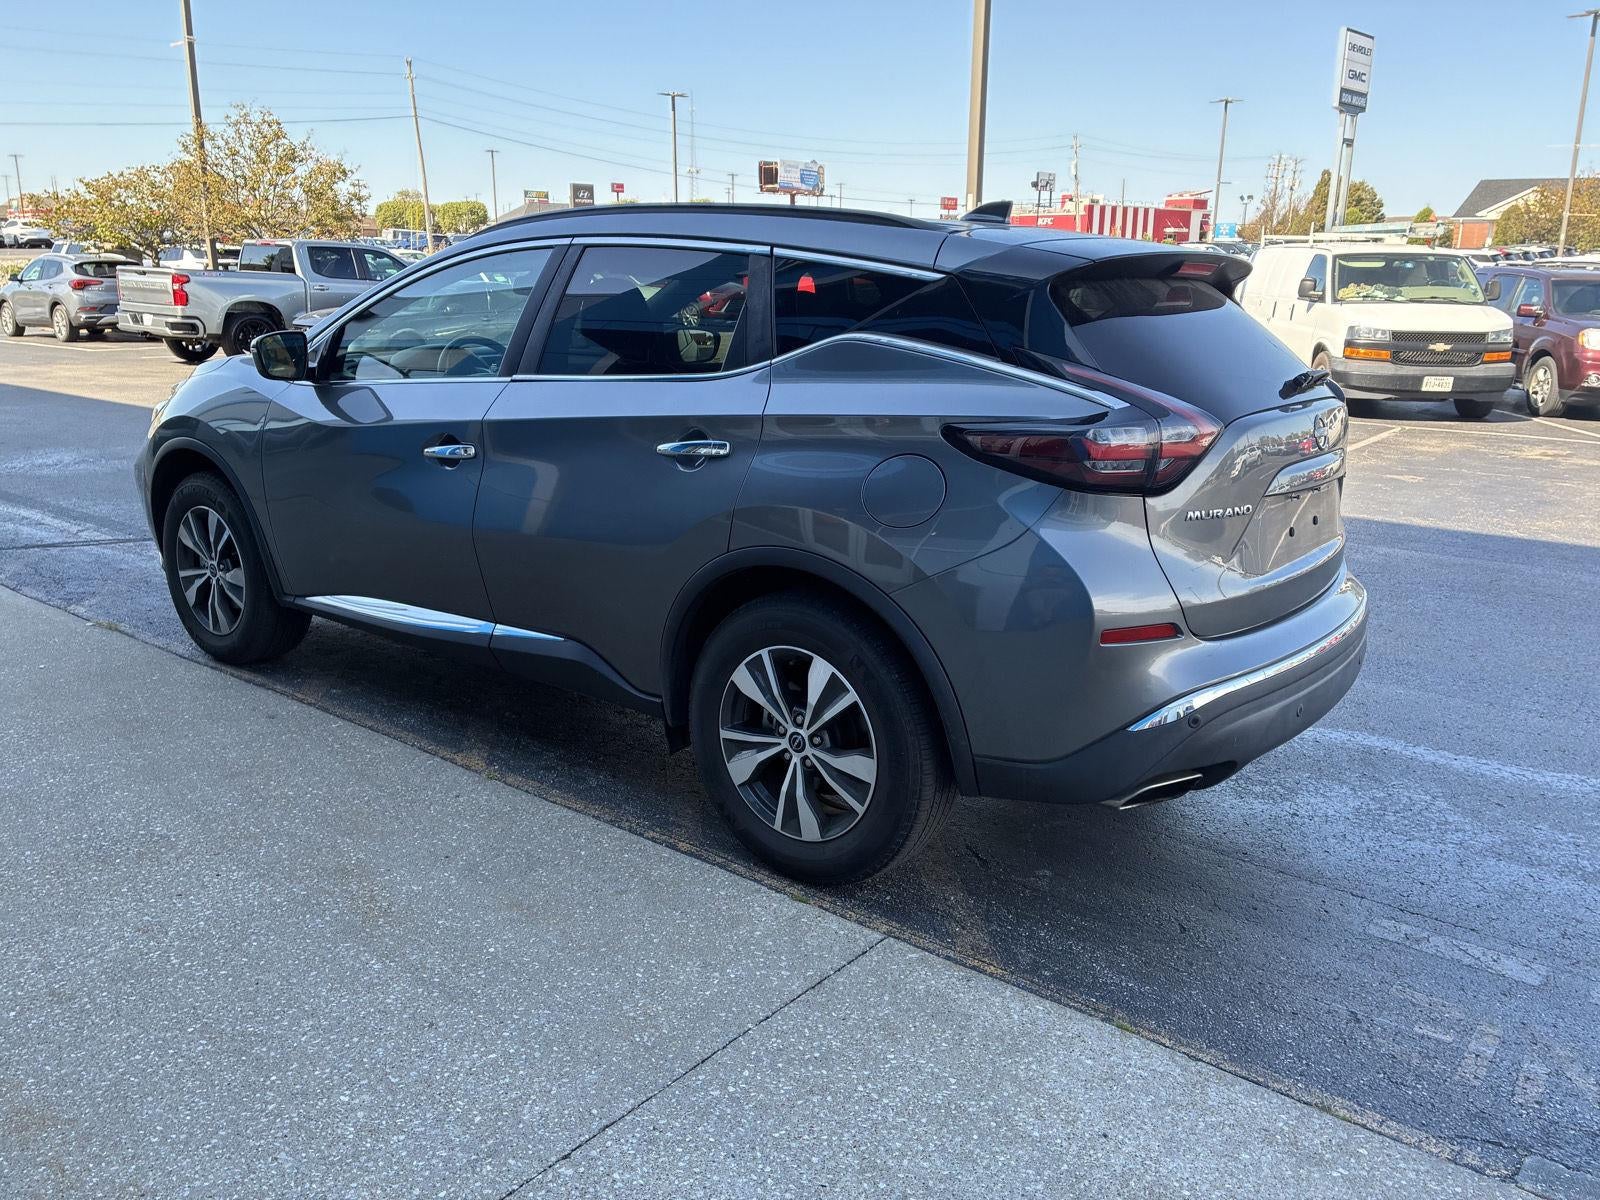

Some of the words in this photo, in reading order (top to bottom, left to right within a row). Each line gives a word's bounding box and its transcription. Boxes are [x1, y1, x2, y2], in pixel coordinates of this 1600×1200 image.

[1348, 42, 1372, 56] CHEVROLET
[1348, 69, 1366, 82] GMC
[1037, 217, 1054, 225] KFC
[1184, 504, 1254, 522] MURANO
